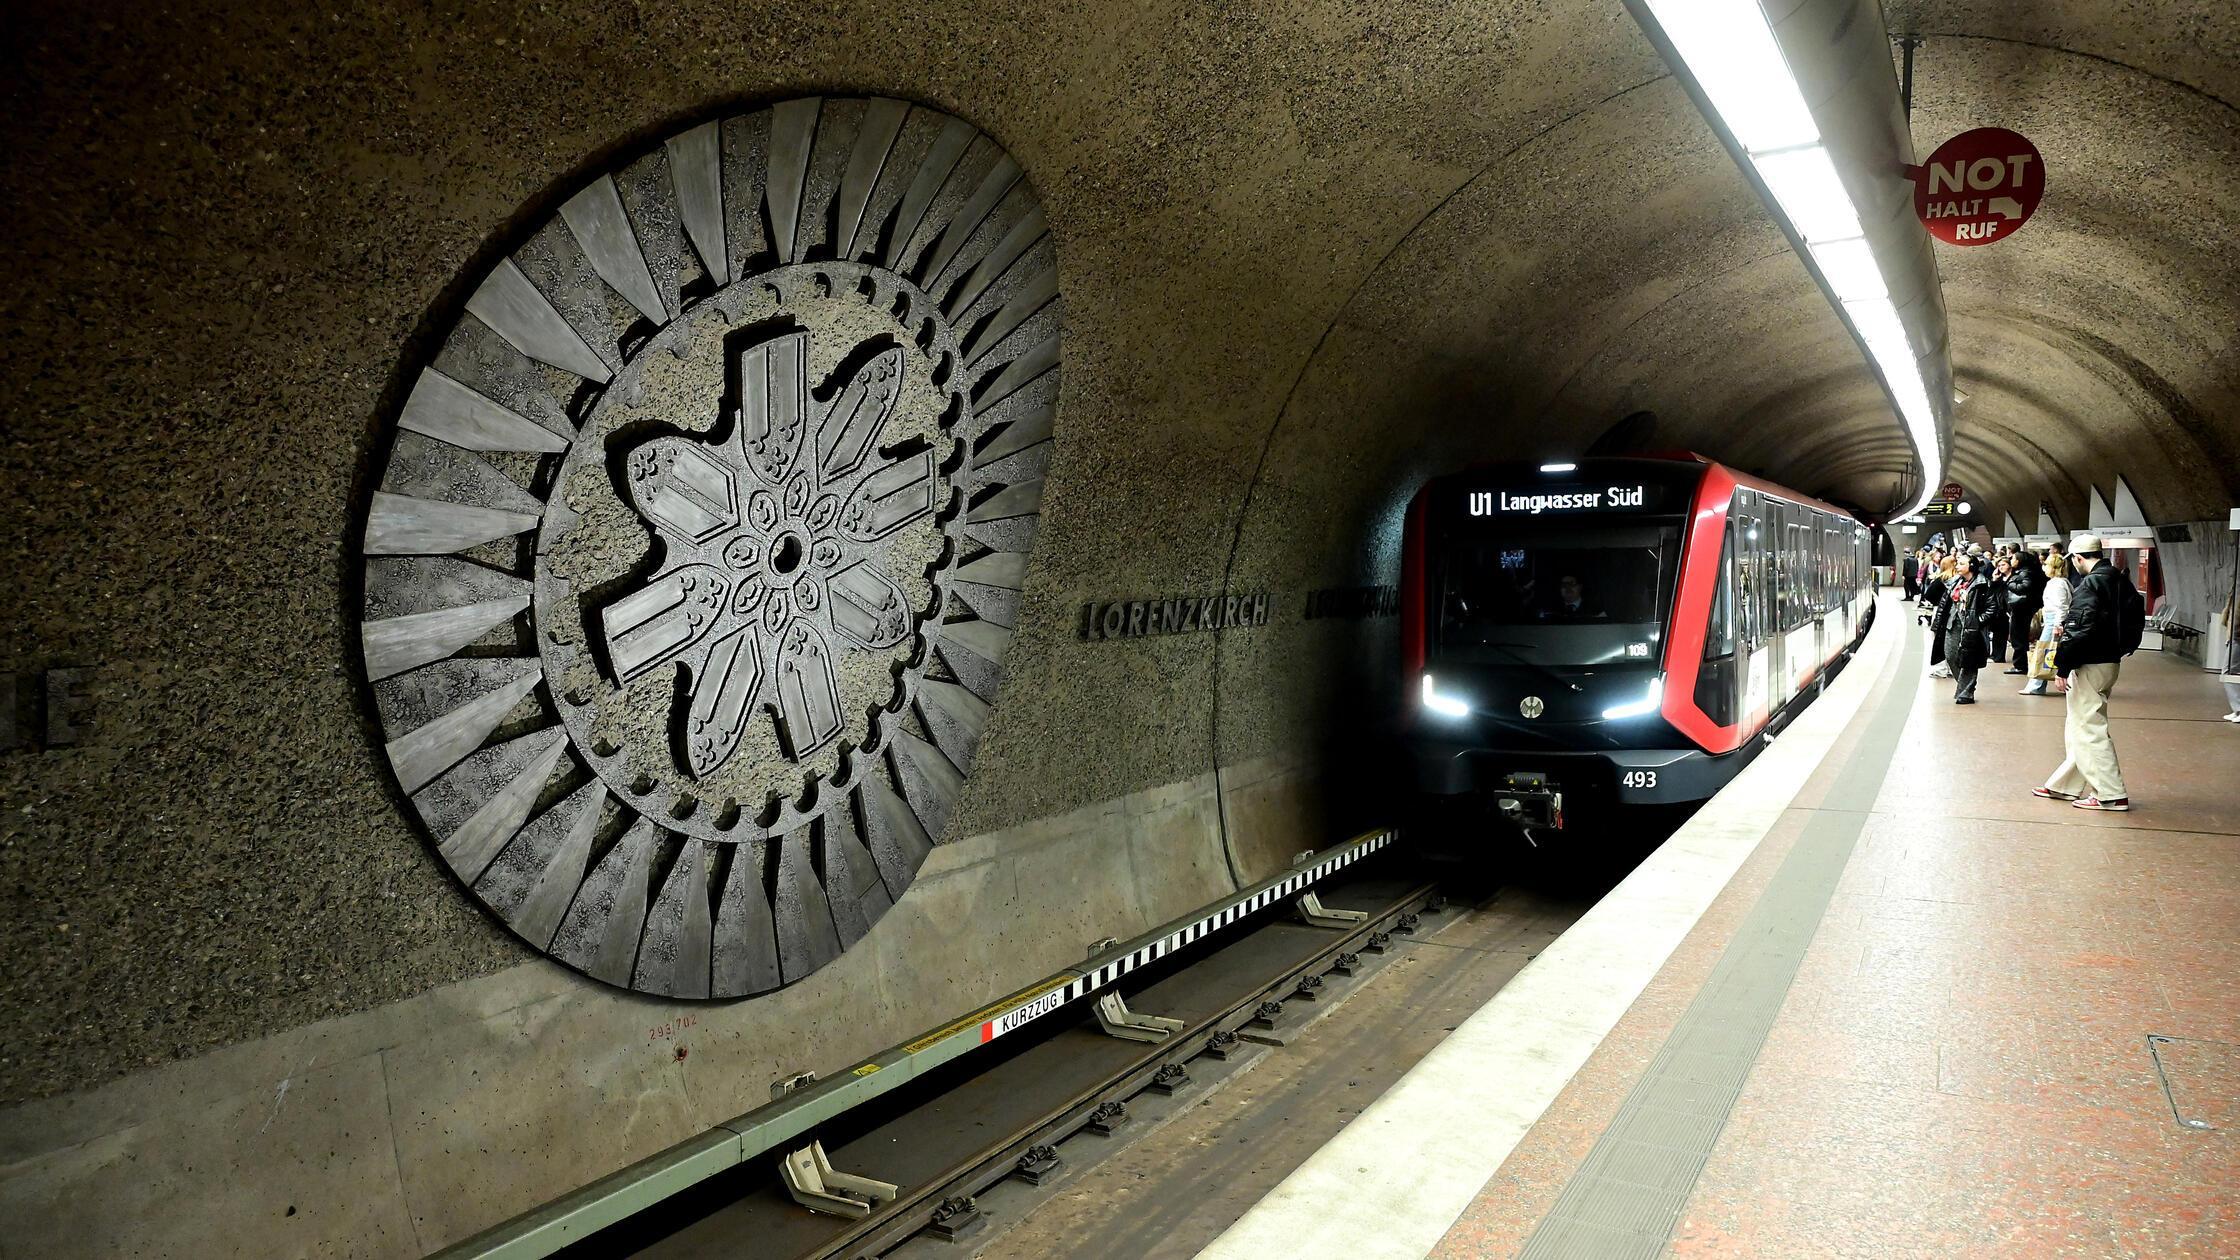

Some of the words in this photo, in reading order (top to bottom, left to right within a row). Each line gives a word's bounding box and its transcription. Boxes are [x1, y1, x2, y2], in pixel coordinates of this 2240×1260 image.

[1928, 154, 2032, 194] NOT
[1926, 199, 1982, 218] HALT
[1956, 221, 1997, 240] RUF
[1470, 493, 1491, 516] U1
[1501, 491, 1601, 514] Langwasser
[1608, 485, 1642, 507] Süd
[1623, 771, 1656, 787] 493
[1002, 993, 1058, 1031] KURZZUG
